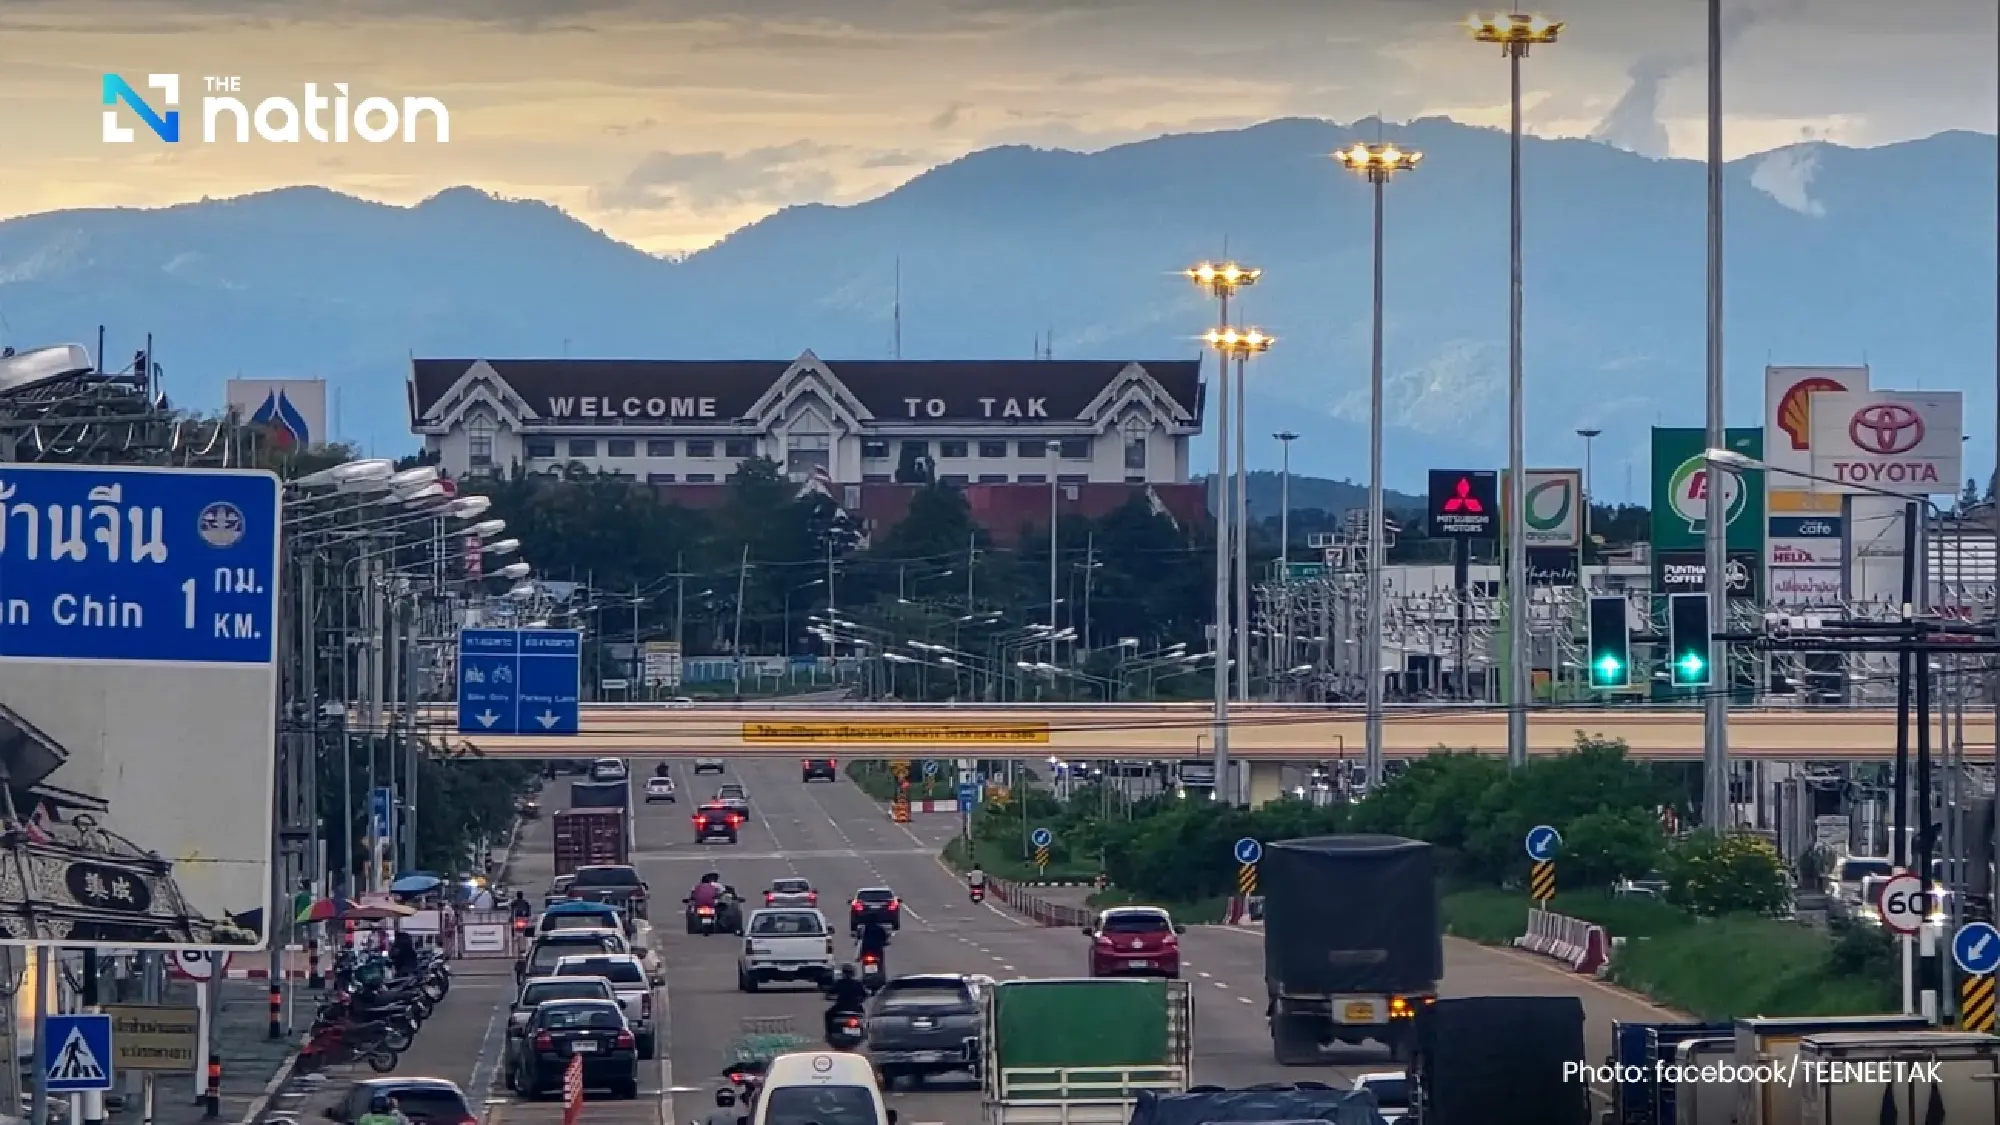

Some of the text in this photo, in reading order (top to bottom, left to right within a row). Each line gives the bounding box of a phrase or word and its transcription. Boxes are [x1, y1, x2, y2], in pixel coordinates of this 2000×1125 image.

[548, 397, 1048, 418] WELCOME TO TAK
[1833, 463, 1938, 482] TOYOTA
[214, 567, 264, 594] กม.
[1664, 565, 1706, 574] PUNTHA
[0, 593, 143, 629] n Chin
[181, 578, 196, 629] 1
[214, 613, 263, 639] KM.
[1888, 890, 1925, 915] 60
